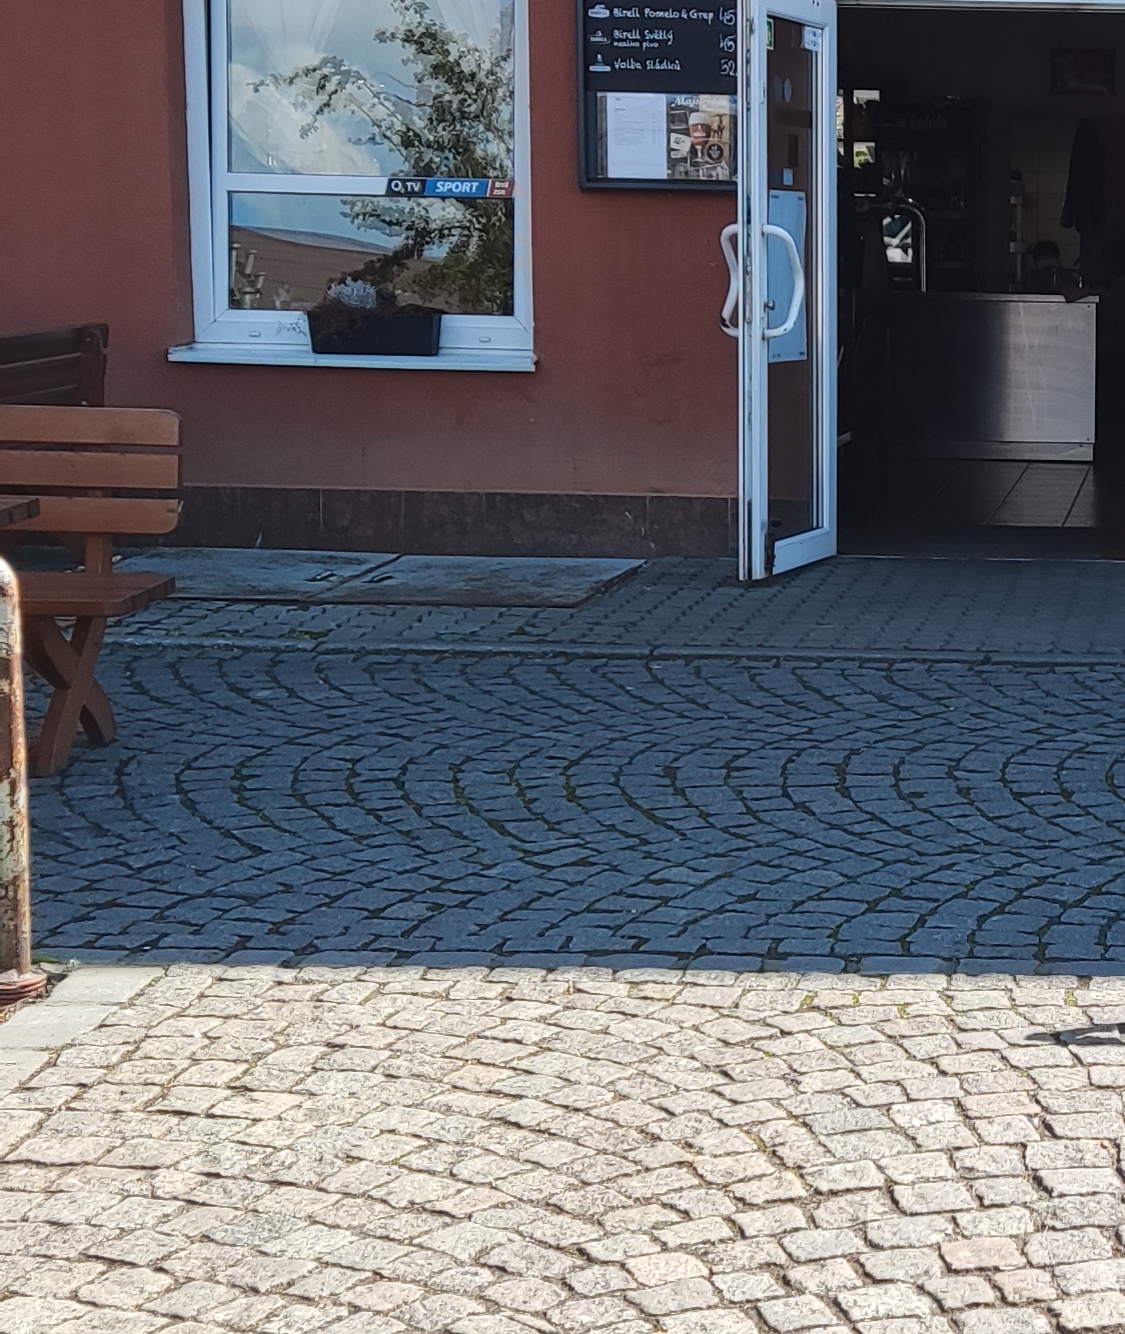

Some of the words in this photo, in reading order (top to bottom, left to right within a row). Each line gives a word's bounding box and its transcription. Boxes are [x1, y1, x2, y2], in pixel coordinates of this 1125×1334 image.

[613, 8, 640, 18] Birell
[644, 8, 679, 18] Pomelo
[681, 9, 688, 19] &
[689, 9, 714, 25] Grep
[613, 29, 640, 39] Birell
[644, 29, 673, 46] Světlý
[642, 40, 659, 51] pivo
[406, 181, 421, 192] TV
[435, 181, 479, 193] SPORT
